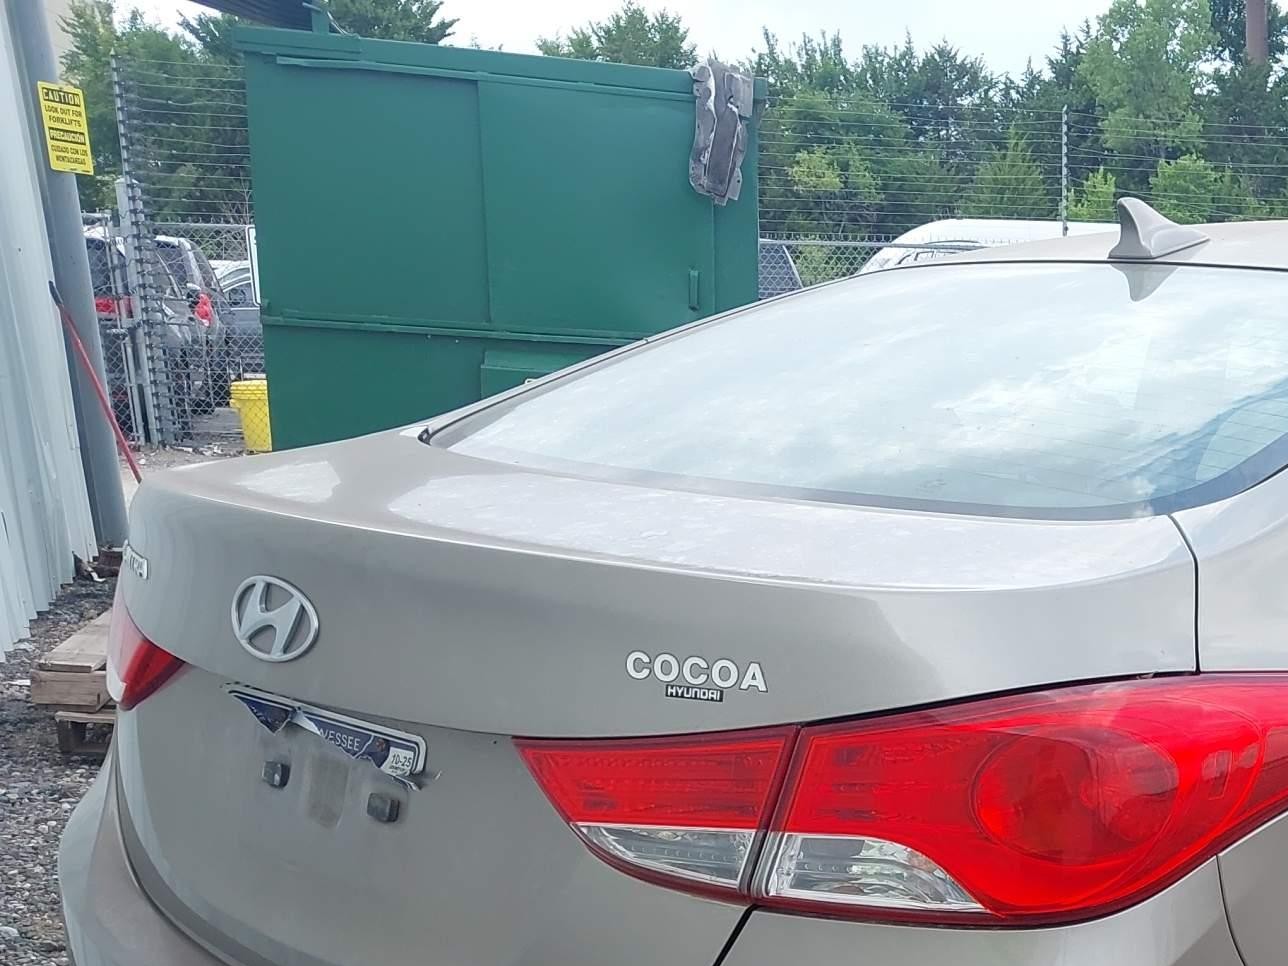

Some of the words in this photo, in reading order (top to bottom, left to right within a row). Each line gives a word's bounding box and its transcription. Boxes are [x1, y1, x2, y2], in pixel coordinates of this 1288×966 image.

[43, 88, 80, 105] CAUTION
[44, 105, 59, 114] LOOK
[60, 107, 70, 116] OUT
[71, 109, 82, 117] FOR
[48, 115, 82, 127] FORKLIFTS
[626, 651, 768, 692] COCOA
[667, 685, 721, 701] HYUNDAI
